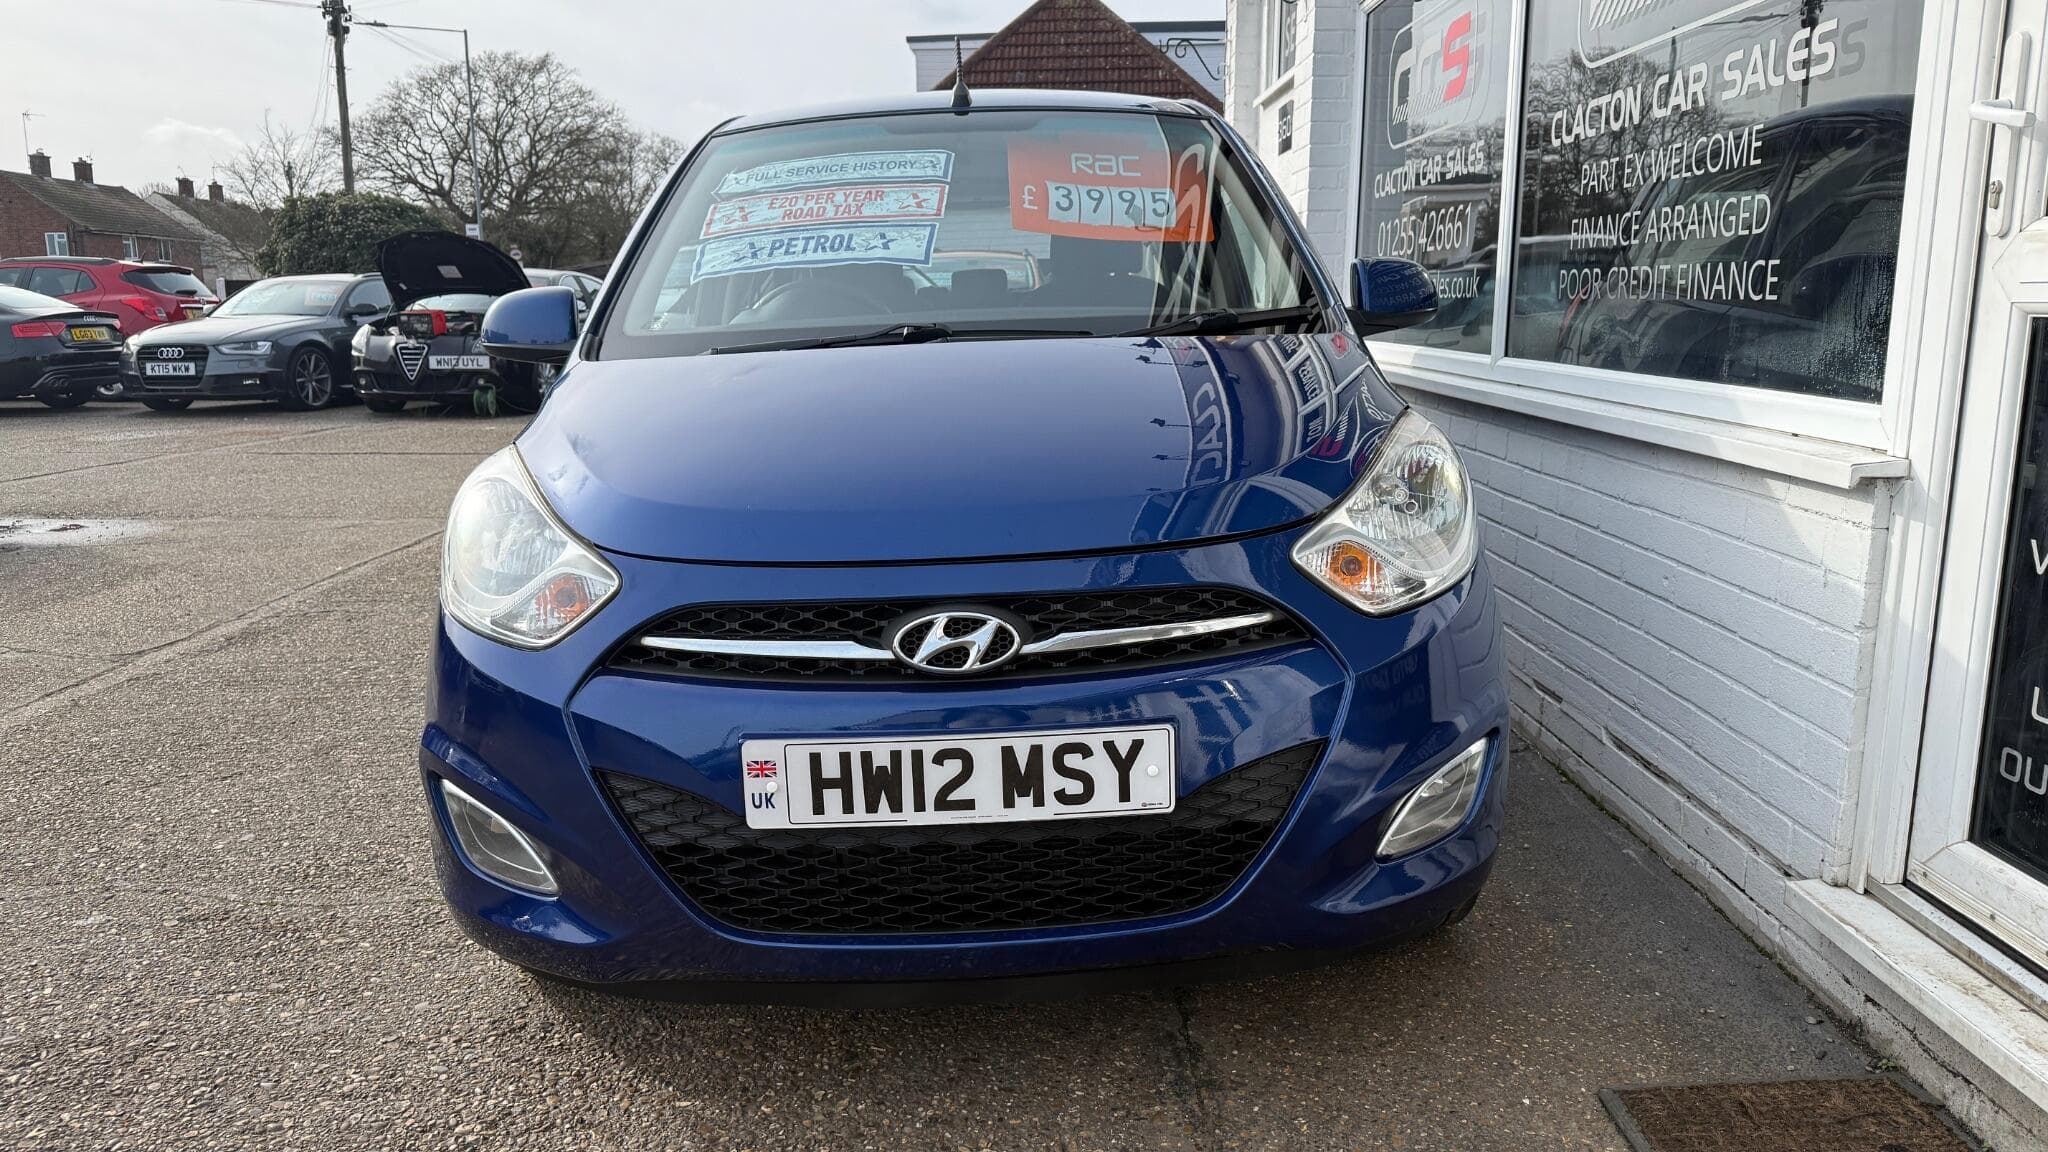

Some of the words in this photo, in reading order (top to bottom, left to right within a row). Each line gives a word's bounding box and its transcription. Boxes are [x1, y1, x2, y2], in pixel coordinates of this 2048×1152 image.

[1551, 83, 1642, 147] CLACTON
[1652, 62, 1708, 118] CAR
[1722, 18, 1838, 100] SALES
[746, 171, 780, 184] FULL
[786, 163, 849, 177] SERVICE
[853, 159, 918, 172] HISTORY
[1374, 160, 1416, 199] CLACTON
[1420, 154, 1442, 186] CAR
[1446, 139, 1485, 180] SALES
[1580, 157, 1619, 196] PART
[1623, 151, 1646, 188] EX
[1651, 123, 1764, 183] WELCOME
[781, 206, 826, 221] ROAD
[833, 203, 864, 217] TAX
[803, 191, 835, 206] PER
[842, 189, 885, 203] YEAR
[1378, 215, 1416, 257] 01255
[1419, 202, 1472, 253] 426661
[1570, 210, 1642, 250] FINANCE
[1645, 193, 1771, 243] ARRANGED
[767, 233, 856, 258] PETROL
[1558, 267, 1602, 300] POOR
[1606, 264, 1671, 301] CREDIT
[1676, 259, 1781, 301] FINANCE
[150, 364, 170, 374] KT15
[172, 364, 190, 374] WKW
[462, 357, 483, 367] UYL
[809, 747, 976, 816] HW12
[1001, 738, 1145, 810] MSY
[751, 792, 776, 809] UK
